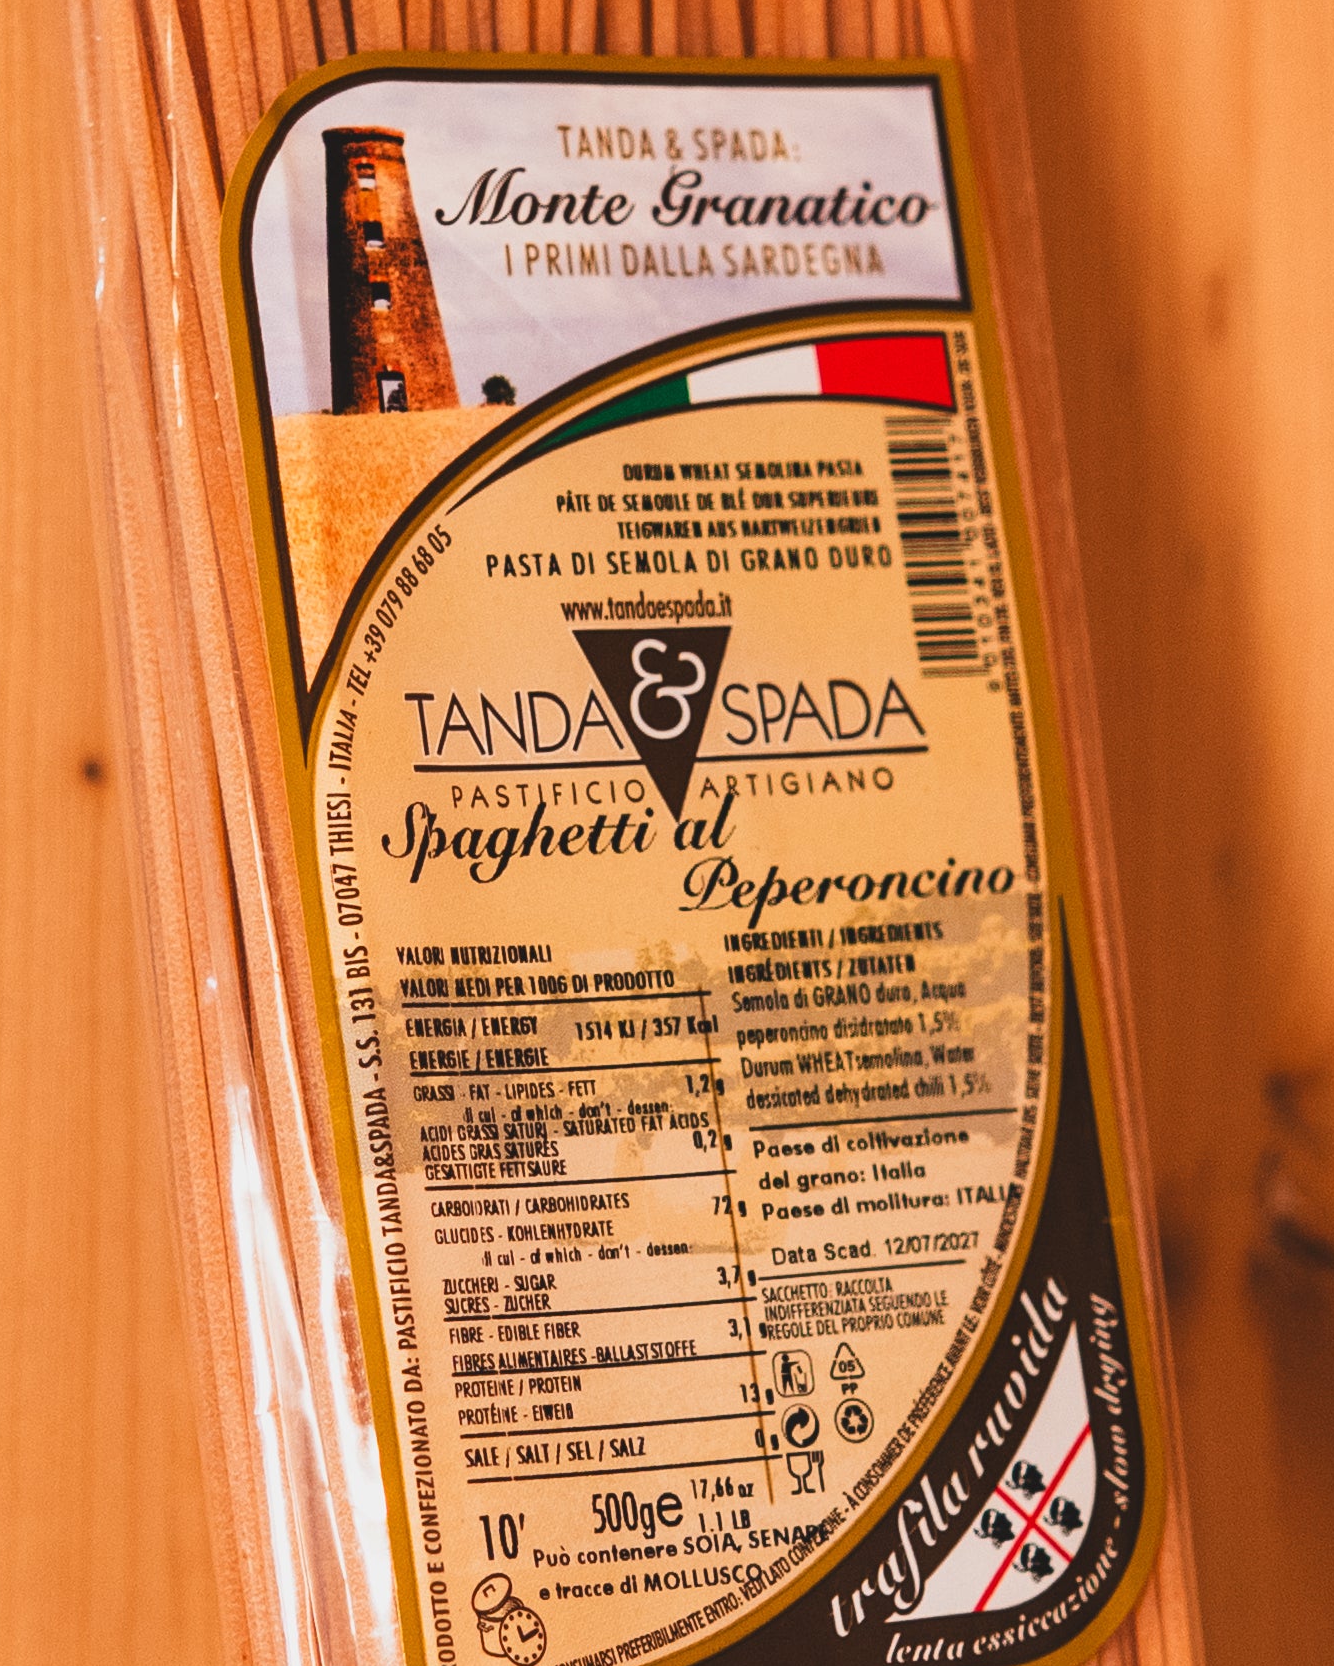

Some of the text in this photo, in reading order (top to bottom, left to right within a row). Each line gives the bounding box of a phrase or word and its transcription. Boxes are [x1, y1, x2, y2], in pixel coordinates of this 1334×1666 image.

[557, 125, 801, 162] TANDA & SPADA:
[435, 167, 934, 226] Monte Granatico
[506, 242, 885, 277] I PRIMI DALLA SARDEGNA
[599, 495, 615, 511] DE
[697, 493, 715, 511] DE
[427, 523, 453, 555] 05
[411, 544, 435, 575] 68
[486, 544, 892, 577] PASTA DI SEMOLA DI GRANO DURO
[395, 566, 419, 597] 88
[376, 589, 404, 629] 079
[561, 589, 732, 624] www.tandaespada.it
[364, 623, 387, 663] +39
[346, 663, 372, 697] TEL
[404, 638, 927, 758] TANDA & SPADA
[329, 709, 358, 771] ITALIA
[451, 767, 894, 810] PASTIFICIO ARTIGIANO
[327, 793, 354, 856] THIESI
[382, 795, 736, 884] Spaghetti al
[333, 864, 363, 927] 07047
[679, 856, 1015, 928] Peperoncino
[396, 945, 552, 966] VALORI NUTRIZIONALI
[724, 929, 823, 951] INGREDIENTI
[343, 945, 371, 980] BIS
[400, 970, 674, 999] VALORI MEDI PER DI PRODOTTO
[731, 988, 789, 1013] Semola
[794, 988, 807, 1009] di
[813, 983, 870, 1007] GRANO
[349, 987, 376, 1024] 131
[406, 1017, 466, 1038] ENERGIA
[482, 1015, 538, 1036] ENERGY
[575, 1021, 613, 1041] 1514
[653, 1016, 681, 1036] 357
[737, 1017, 828, 1050] peperoncino
[410, 1048, 549, 1070] ENERGIE ENERGIE
[741, 1056, 794, 1079] Durum
[414, 1080, 596, 1101] GRASSI FAT LIPIDES FETT
[420, 1125, 453, 1142] ACIDI
[564, 1116, 636, 1136] SATURATED
[642, 1114, 663, 1131] FAT
[669, 1112, 709, 1130] ACIDS
[423, 1143, 501, 1162] ACIDES GRAS
[754, 1128, 970, 1159] Paese di coltivazione
[363, 1087, 403, 1237] TANDA&SPADA
[759, 1162, 926, 1192] del grano: Italia
[763, 1191, 950, 1220] Paese di molitura:
[435, 1220, 614, 1245] GLUCIDES KOHLENHYDRATE
[772, 1242, 817, 1266] Data
[885, 1231, 979, 1256] 12/07/2027
[385, 1242, 417, 1351] PASTIFICIO
[515, 1274, 557, 1292] SUGAR
[445, 1297, 490, 1315] SUCRES
[765, 1296, 866, 1322] INDIFFERENZIATA
[450, 1322, 580, 1344] FIBRE EDIBLE FIBER
[453, 1355, 495, 1372] FIBRES
[839, 1360, 855, 1372] 05
[455, 1375, 582, 1398] PROTEINE PROTEIN
[842, 1383, 858, 1394] PP
[464, 1437, 646, 1468] SALE SALT SEL SALZ
[829, 1470, 971, 1638] trafila
[969, 1276, 1068, 1479] ruvida
[406, 1400, 442, 1556] CONFEZIONATO
[732, 1509, 751, 1530] LB
[428, 1561, 444, 1574] E
[534, 1545, 571, 1568] Può
[577, 1542, 677, 1566] contenere
[539, 1587, 549, 1601] e
[556, 1578, 614, 1600] tracce
[621, 1574, 636, 1594] di
[886, 1535, 1120, 1664] lenta essiccazione
[616, 1610, 706, 1663] PREFERIBILMENTE
